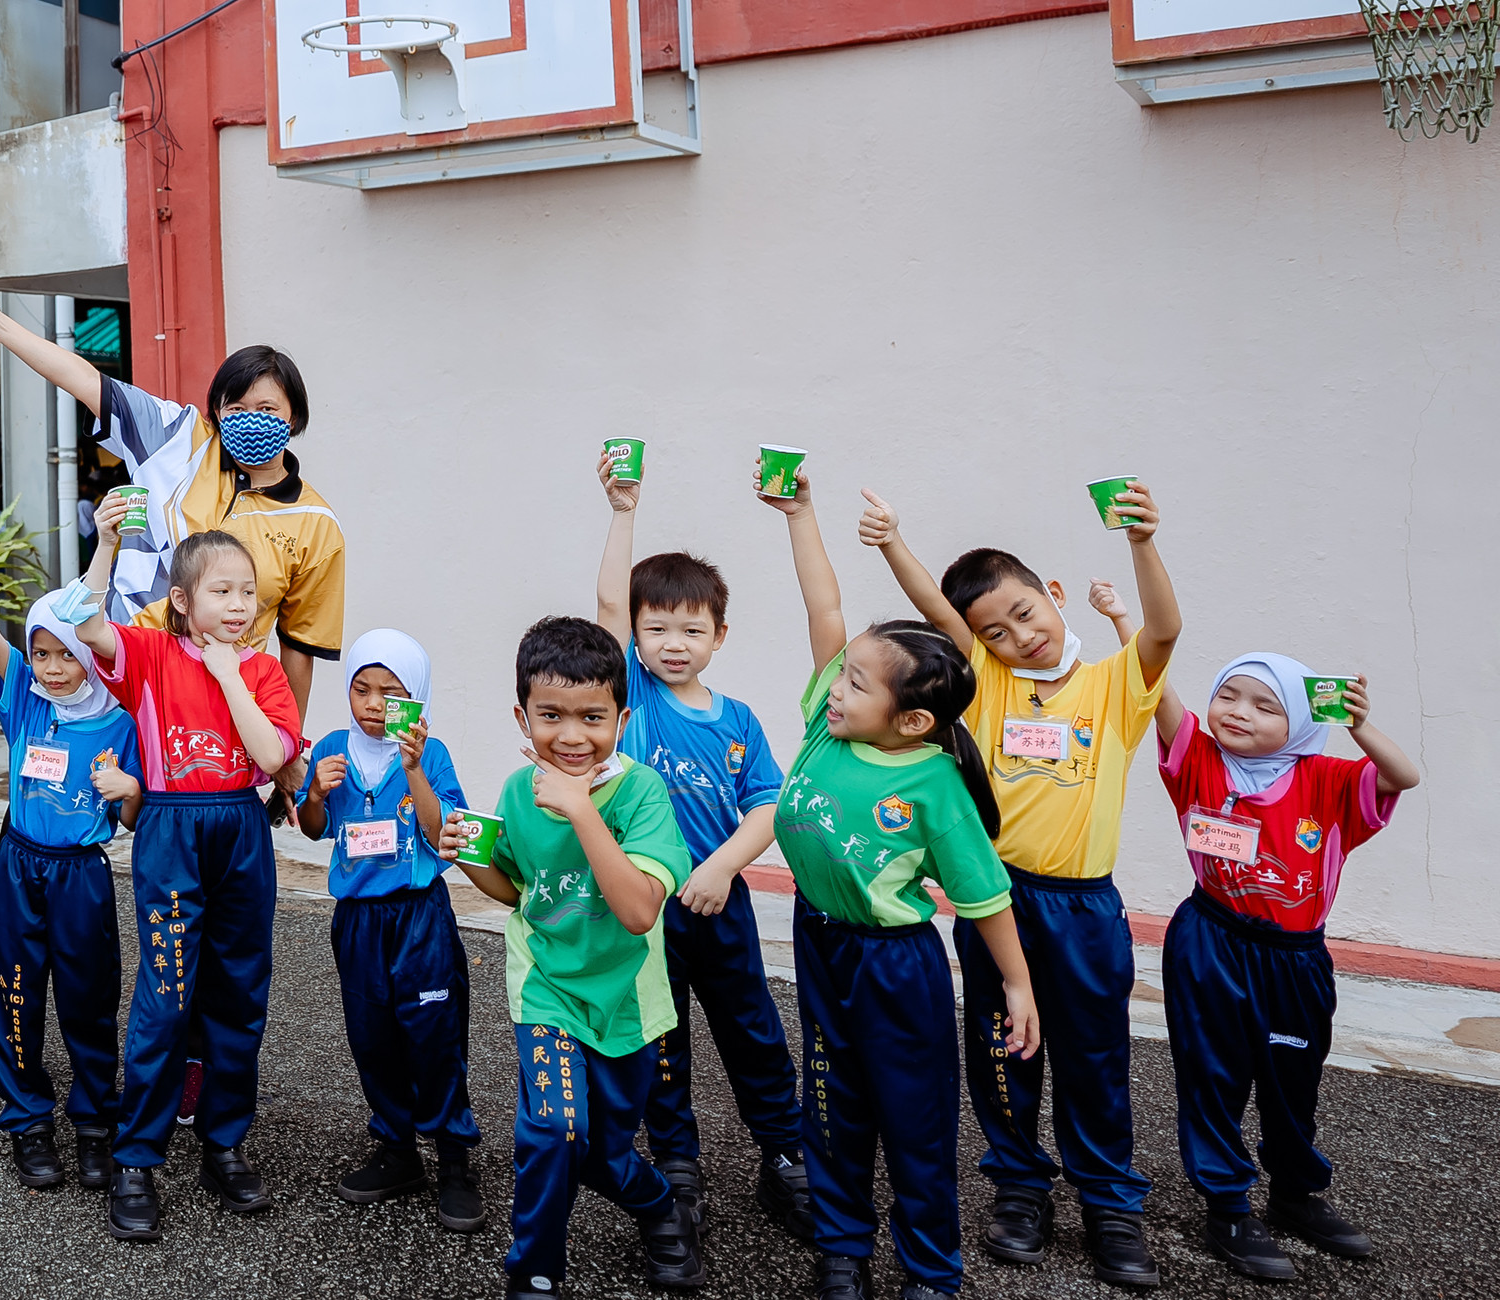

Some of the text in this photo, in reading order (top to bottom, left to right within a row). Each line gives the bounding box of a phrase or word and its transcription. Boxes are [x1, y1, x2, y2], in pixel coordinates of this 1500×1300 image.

[609, 447, 630, 460] MILO
[1317, 683, 1335, 691] MILO
[1020, 726, 1033, 734] Soo
[1021, 736, 1060, 750] 苏诗杰
[41, 754, 60, 764] Inara
[365, 829, 386, 837] Aleena
[1205, 824, 1242, 840] Fatimah
[1199, 835, 1241, 855] 法迪玛
[170, 890, 181, 919] SJK
[169, 923, 185, 935] (C)
[148, 908, 171, 997] 公民华小
[174, 938, 184, 979] KONG
[9, 964, 25, 1070] SJK (C) KONG MIN
[810, 1059, 830, 1073] (C)
[990, 1012, 1009, 1104] SJK (C) KONG
[531, 1024, 554, 1118] 公民华小
[555, 1038, 576, 1143] (C) KONG MIN
[816, 1078, 829, 1123] KONG
